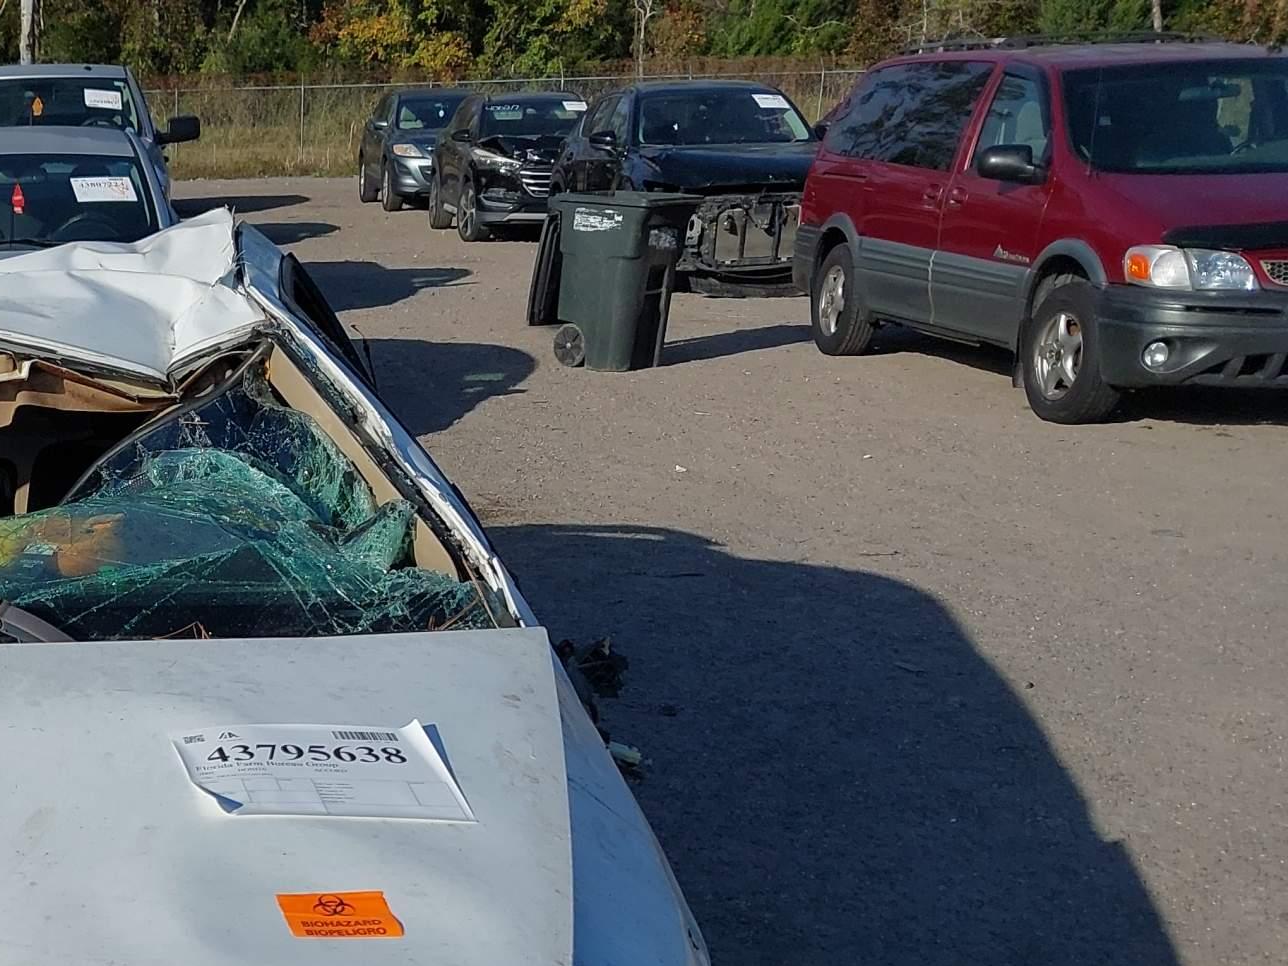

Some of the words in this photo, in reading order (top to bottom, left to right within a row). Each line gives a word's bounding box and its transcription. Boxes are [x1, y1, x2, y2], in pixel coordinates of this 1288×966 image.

[207, 744, 407, 765] 43795638
[196, 763, 234, 772] Florida
[305, 761, 339, 769] Group
[301, 920, 382, 928] BIOHAZARD
[305, 927, 387, 936] BIOPELIGRO
